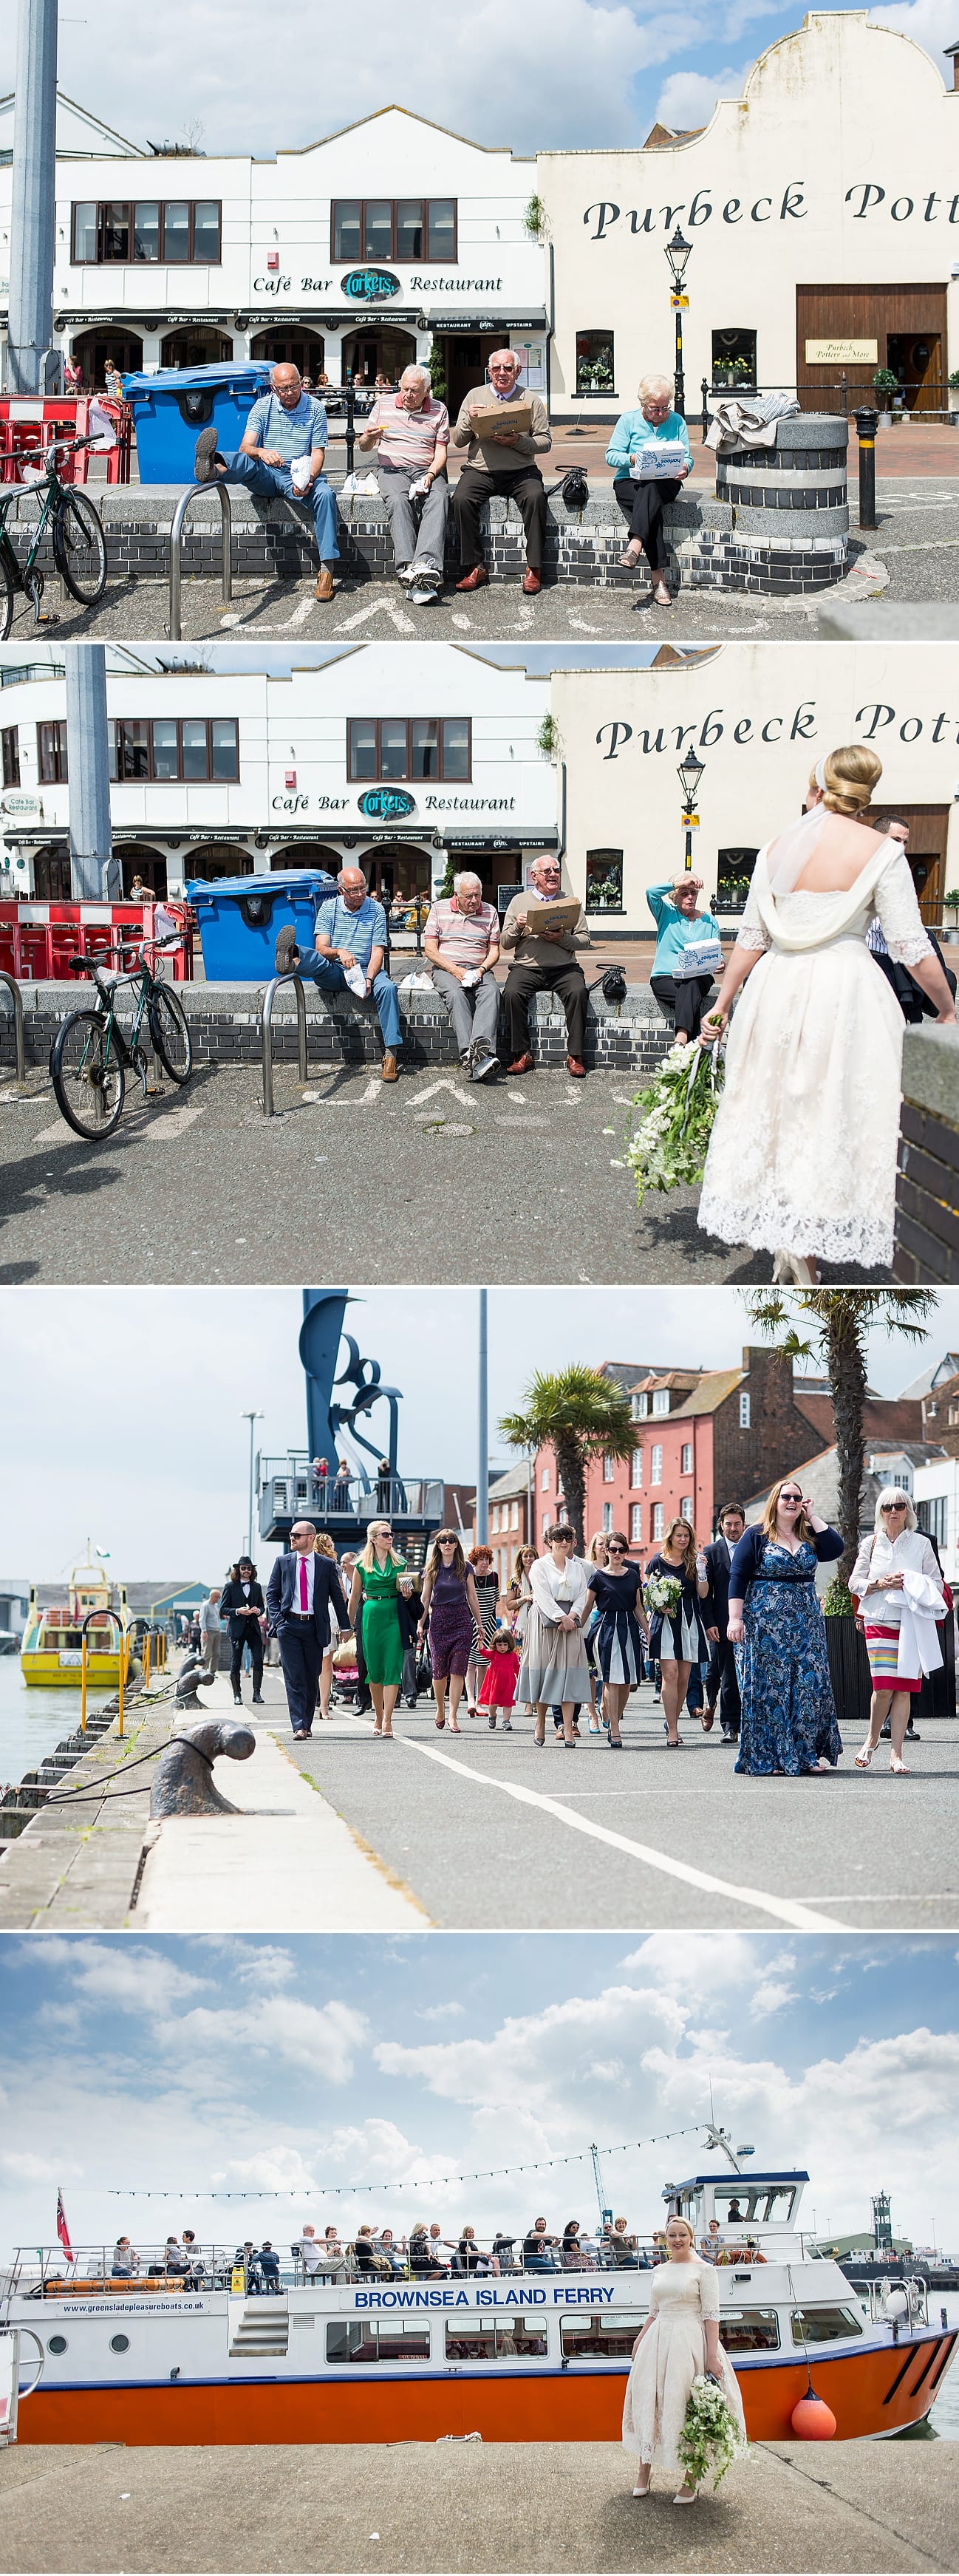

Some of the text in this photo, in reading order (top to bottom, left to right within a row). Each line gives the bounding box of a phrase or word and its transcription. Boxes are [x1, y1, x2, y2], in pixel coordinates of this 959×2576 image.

[584, 181, 808, 240] Purbeck
[253, 276, 333, 296] Café Bar
[347, 271, 395, 299] Corkers
[410, 276, 503, 291] Restaurant
[816, 351, 841, 361] Pottery
[827, 343, 853, 352] Purbeck
[596, 701, 959, 760] Purbeck Pot
[272, 794, 350, 814] Café Bar
[363, 790, 410, 819] Corkers
[426, 796, 516, 809] Restaurant
[64, 2302, 204, 2313] www.greensladepleasureboats.co.uk
[355, 2287, 615, 2308] BROWNSEA ISLAND FERRY
